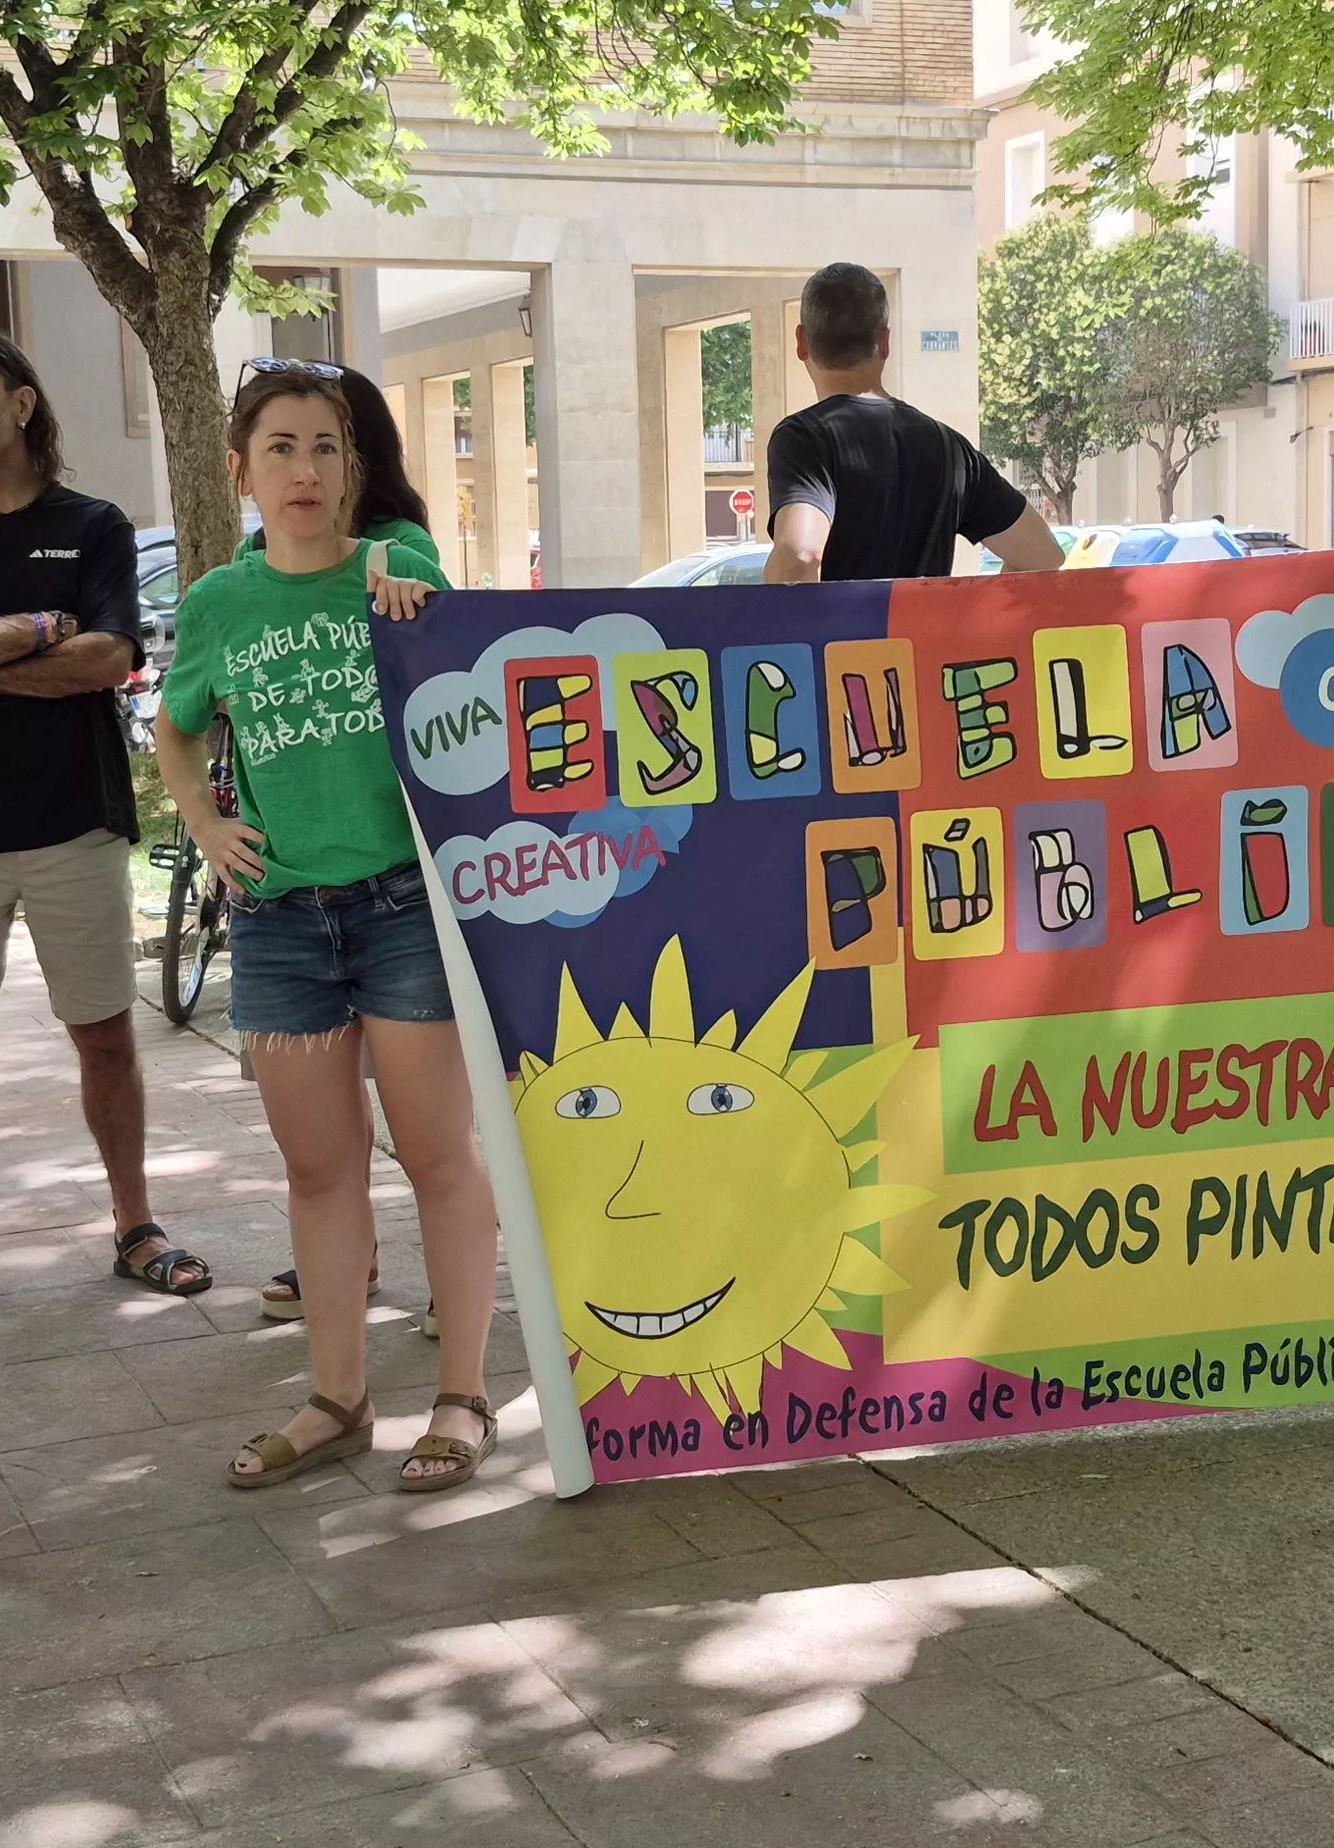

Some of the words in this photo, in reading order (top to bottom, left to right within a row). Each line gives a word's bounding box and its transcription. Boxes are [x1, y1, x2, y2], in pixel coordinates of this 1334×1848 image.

[225, 621, 321, 677] ESCUELA
[246, 718, 321, 759] PARA
[247, 683, 285, 713] DE
[410, 696, 502, 760] VIVA
[517, 644, 1231, 795] ESCUELA
[453, 824, 667, 906] CREATIVA
[973, 1060, 1058, 1142] LA
[939, 1183, 1160, 1290] TODOS
[586, 1416, 701, 1461] forma
[724, 1409, 768, 1451] en
[787, 1384, 947, 1445] Defensa
[968, 1371, 1015, 1422] de
[1030, 1365, 1063, 1410] la
[1081, 1348, 1225, 1411] Escuela
